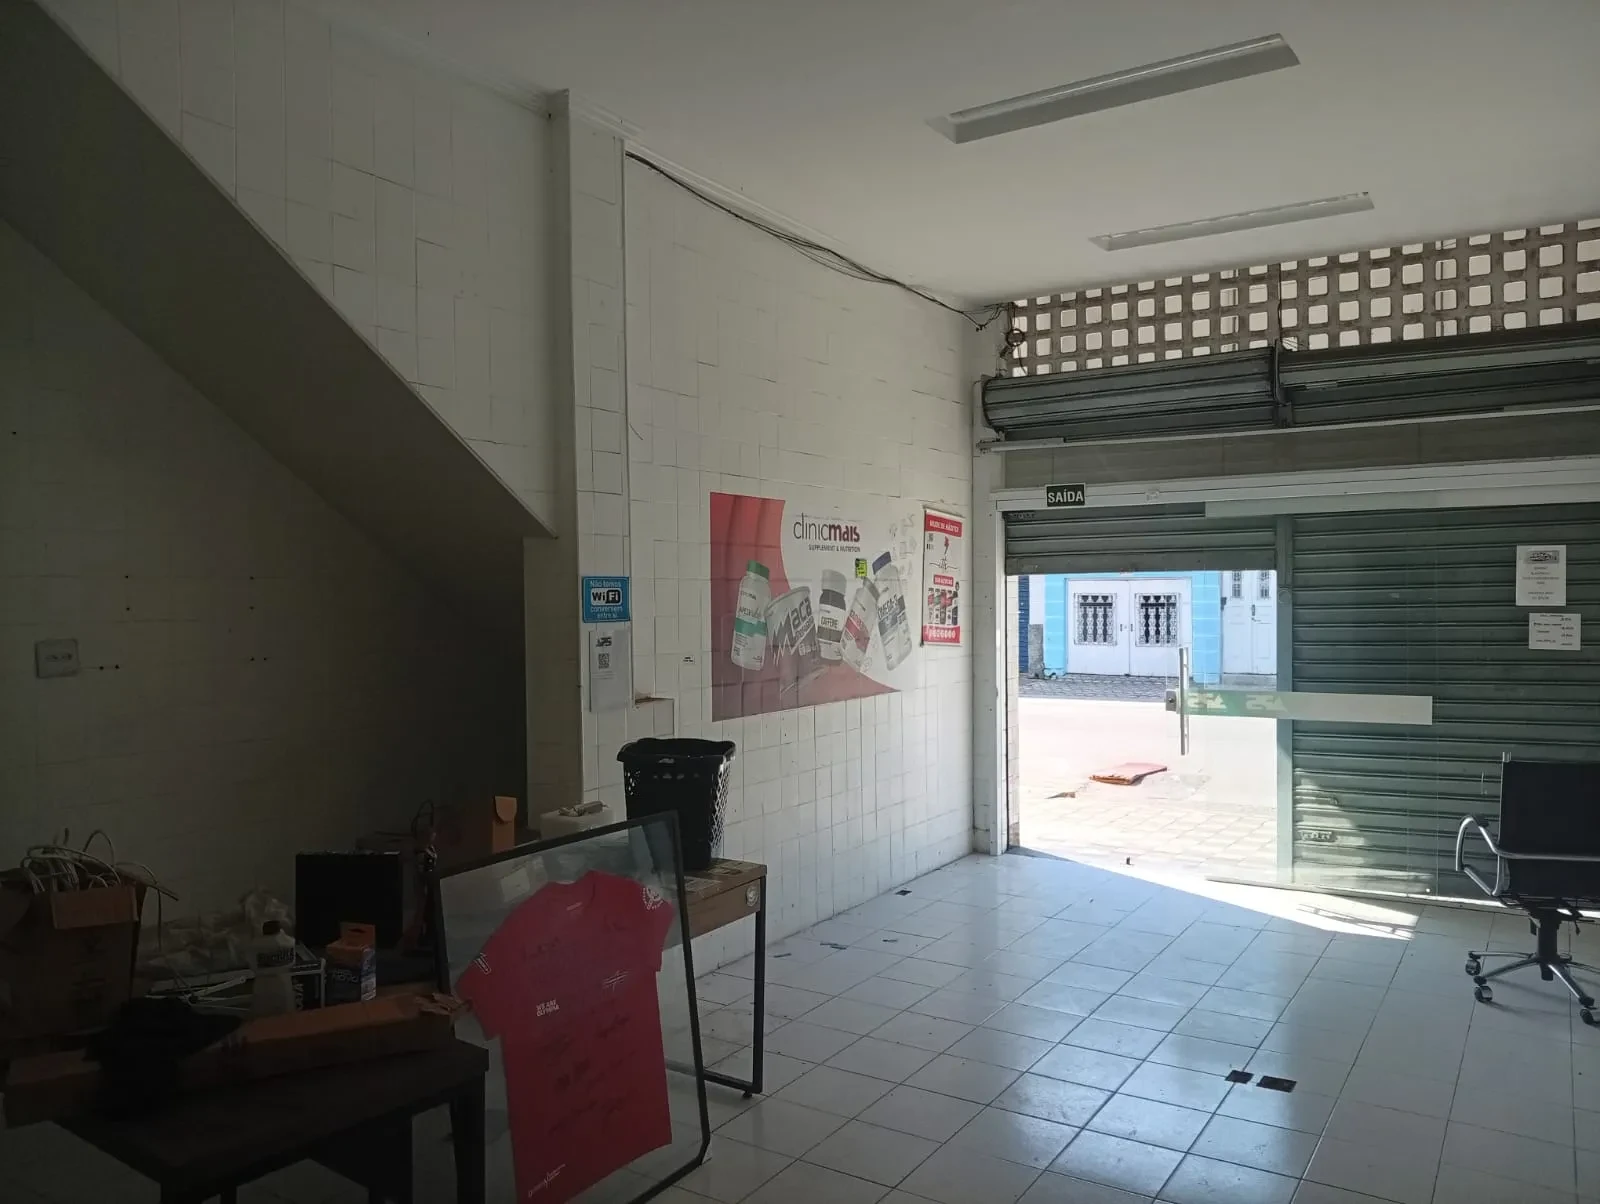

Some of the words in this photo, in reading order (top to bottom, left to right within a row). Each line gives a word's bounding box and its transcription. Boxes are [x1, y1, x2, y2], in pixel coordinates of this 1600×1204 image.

[1048, 489, 1083, 503] SAÍDA
[793, 512, 861, 542] clinicmais
[808, 544, 836, 552] SUPPLEMENT
[840, 545, 861, 553] NUTRITION
[590, 580, 602, 588] Não
[592, 590, 620, 603] WiFi
